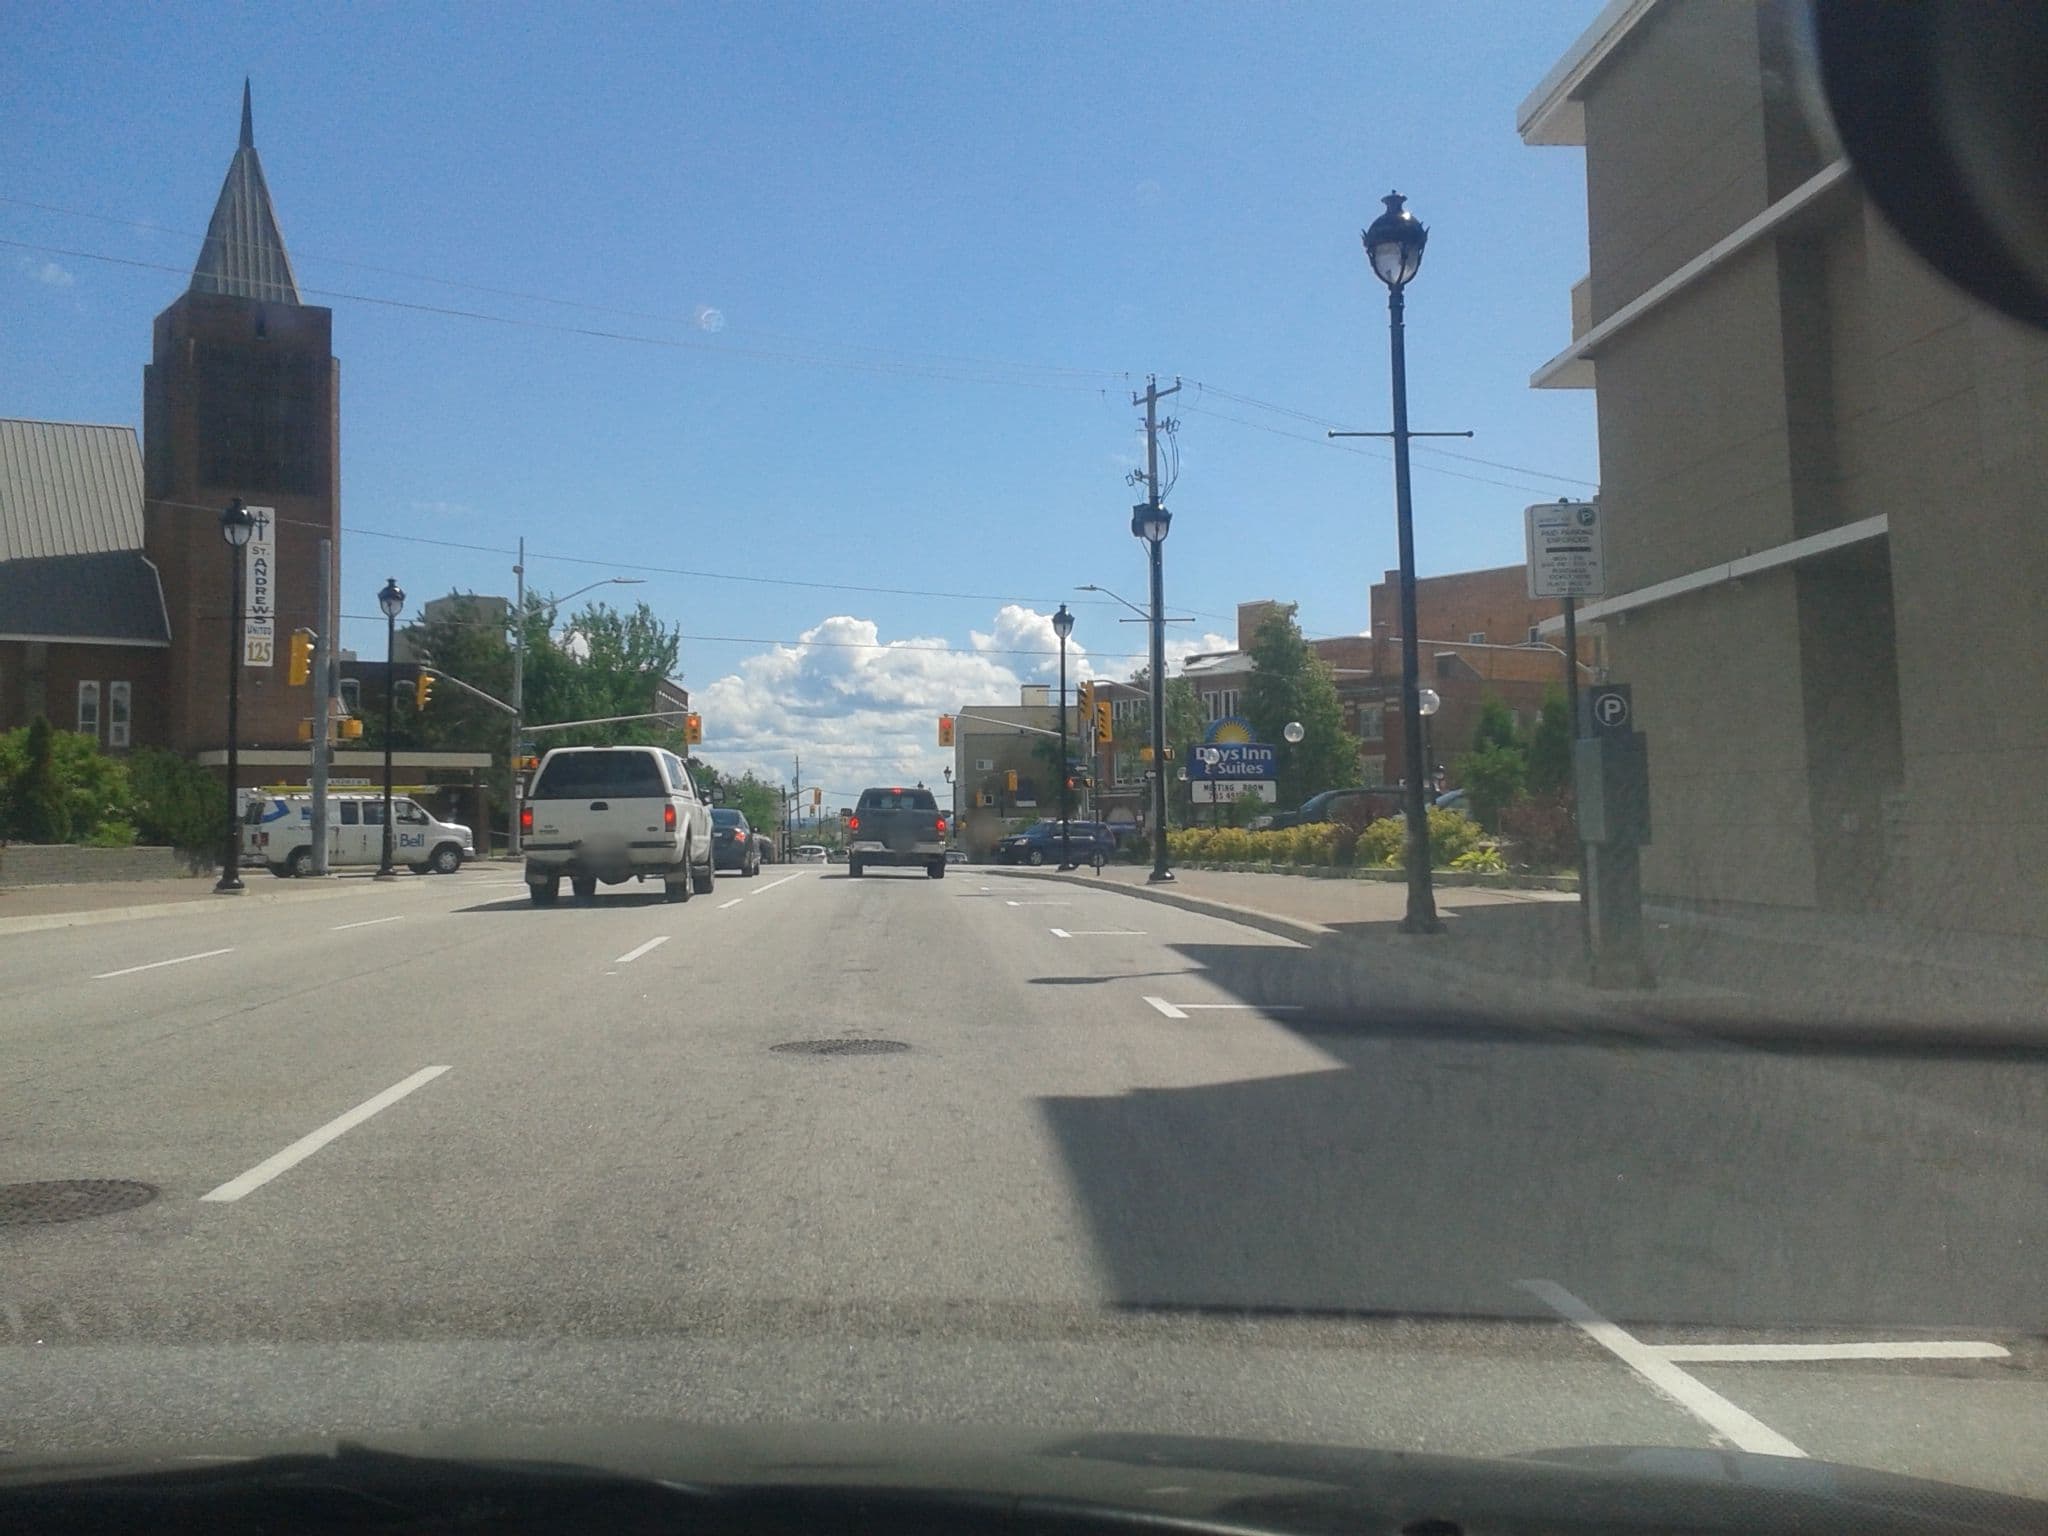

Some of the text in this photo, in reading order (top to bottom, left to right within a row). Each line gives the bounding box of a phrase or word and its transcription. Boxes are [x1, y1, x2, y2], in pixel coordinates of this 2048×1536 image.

[252, 558, 269, 624] ANDREWS
[247, 641, 272, 662] 125
[1195, 746, 1272, 762] Dys Inn
[1217, 761, 1264, 775] Suites
[400, 833, 425, 847] Bell
